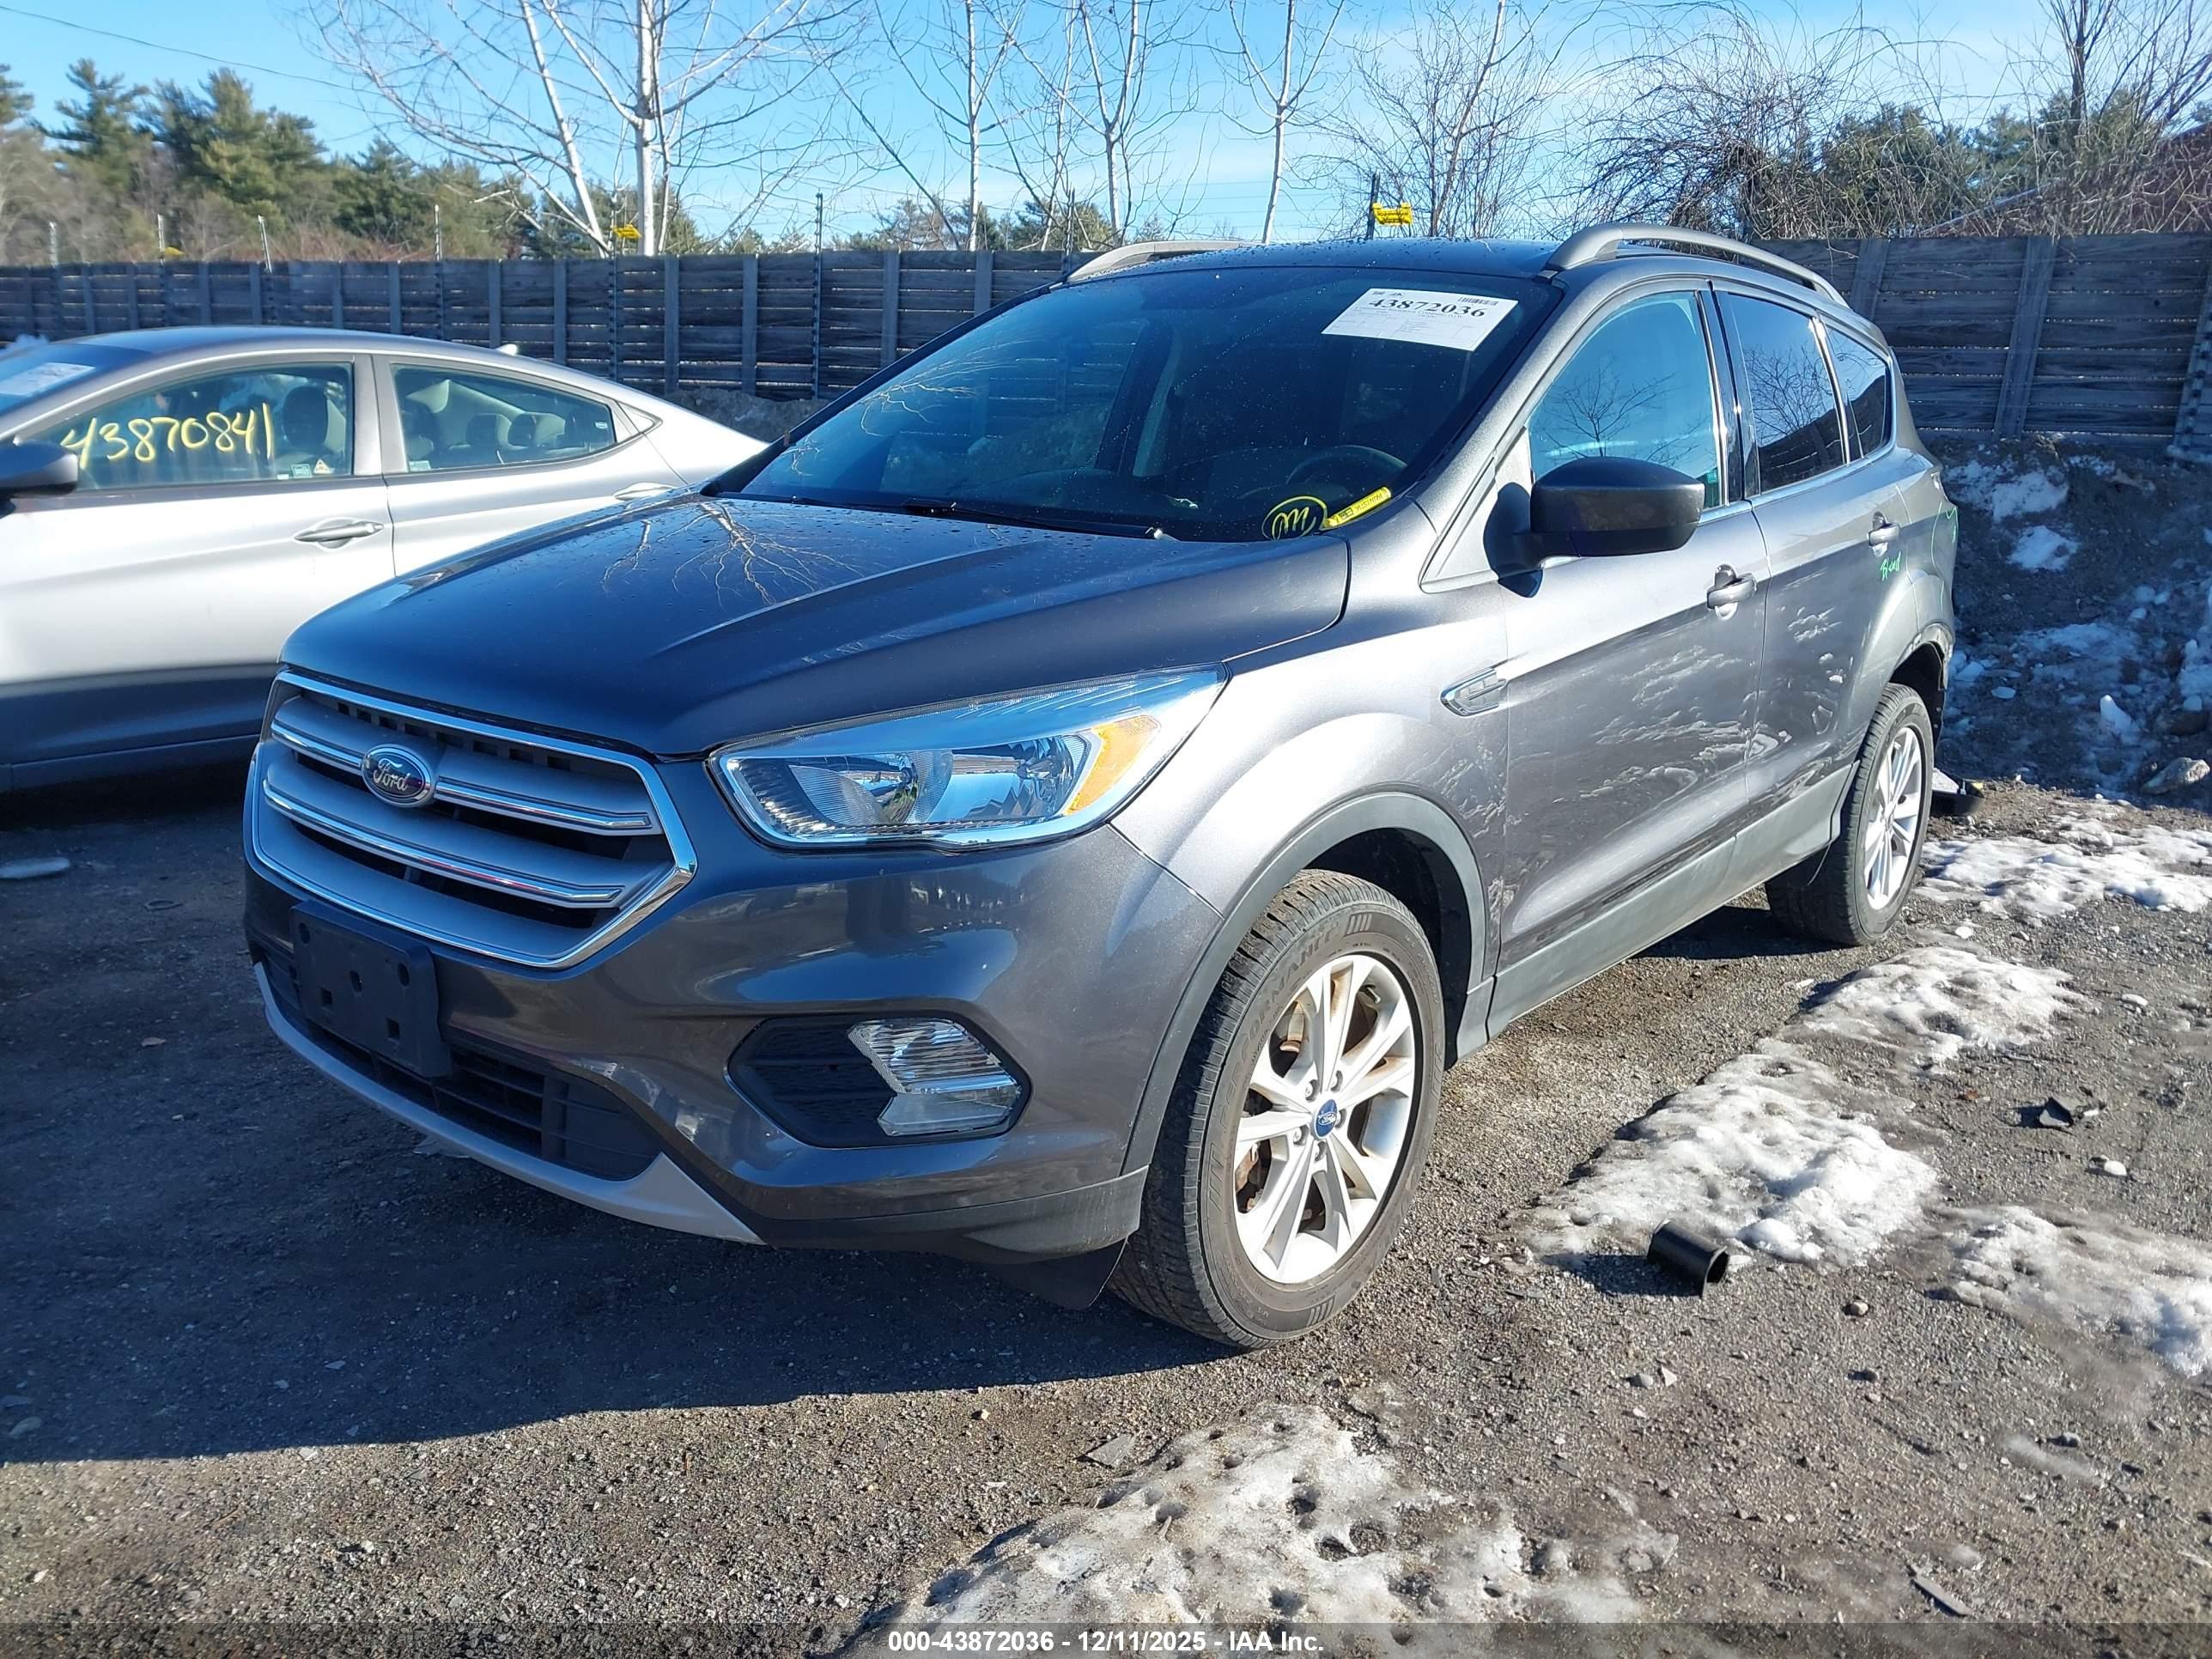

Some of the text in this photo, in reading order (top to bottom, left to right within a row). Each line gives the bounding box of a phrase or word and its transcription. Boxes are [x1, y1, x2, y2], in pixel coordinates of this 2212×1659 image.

[1368, 297, 1486, 318] 43872036
[59, 402, 274, 470] 43870841
[373, 757, 410, 792] Ford
